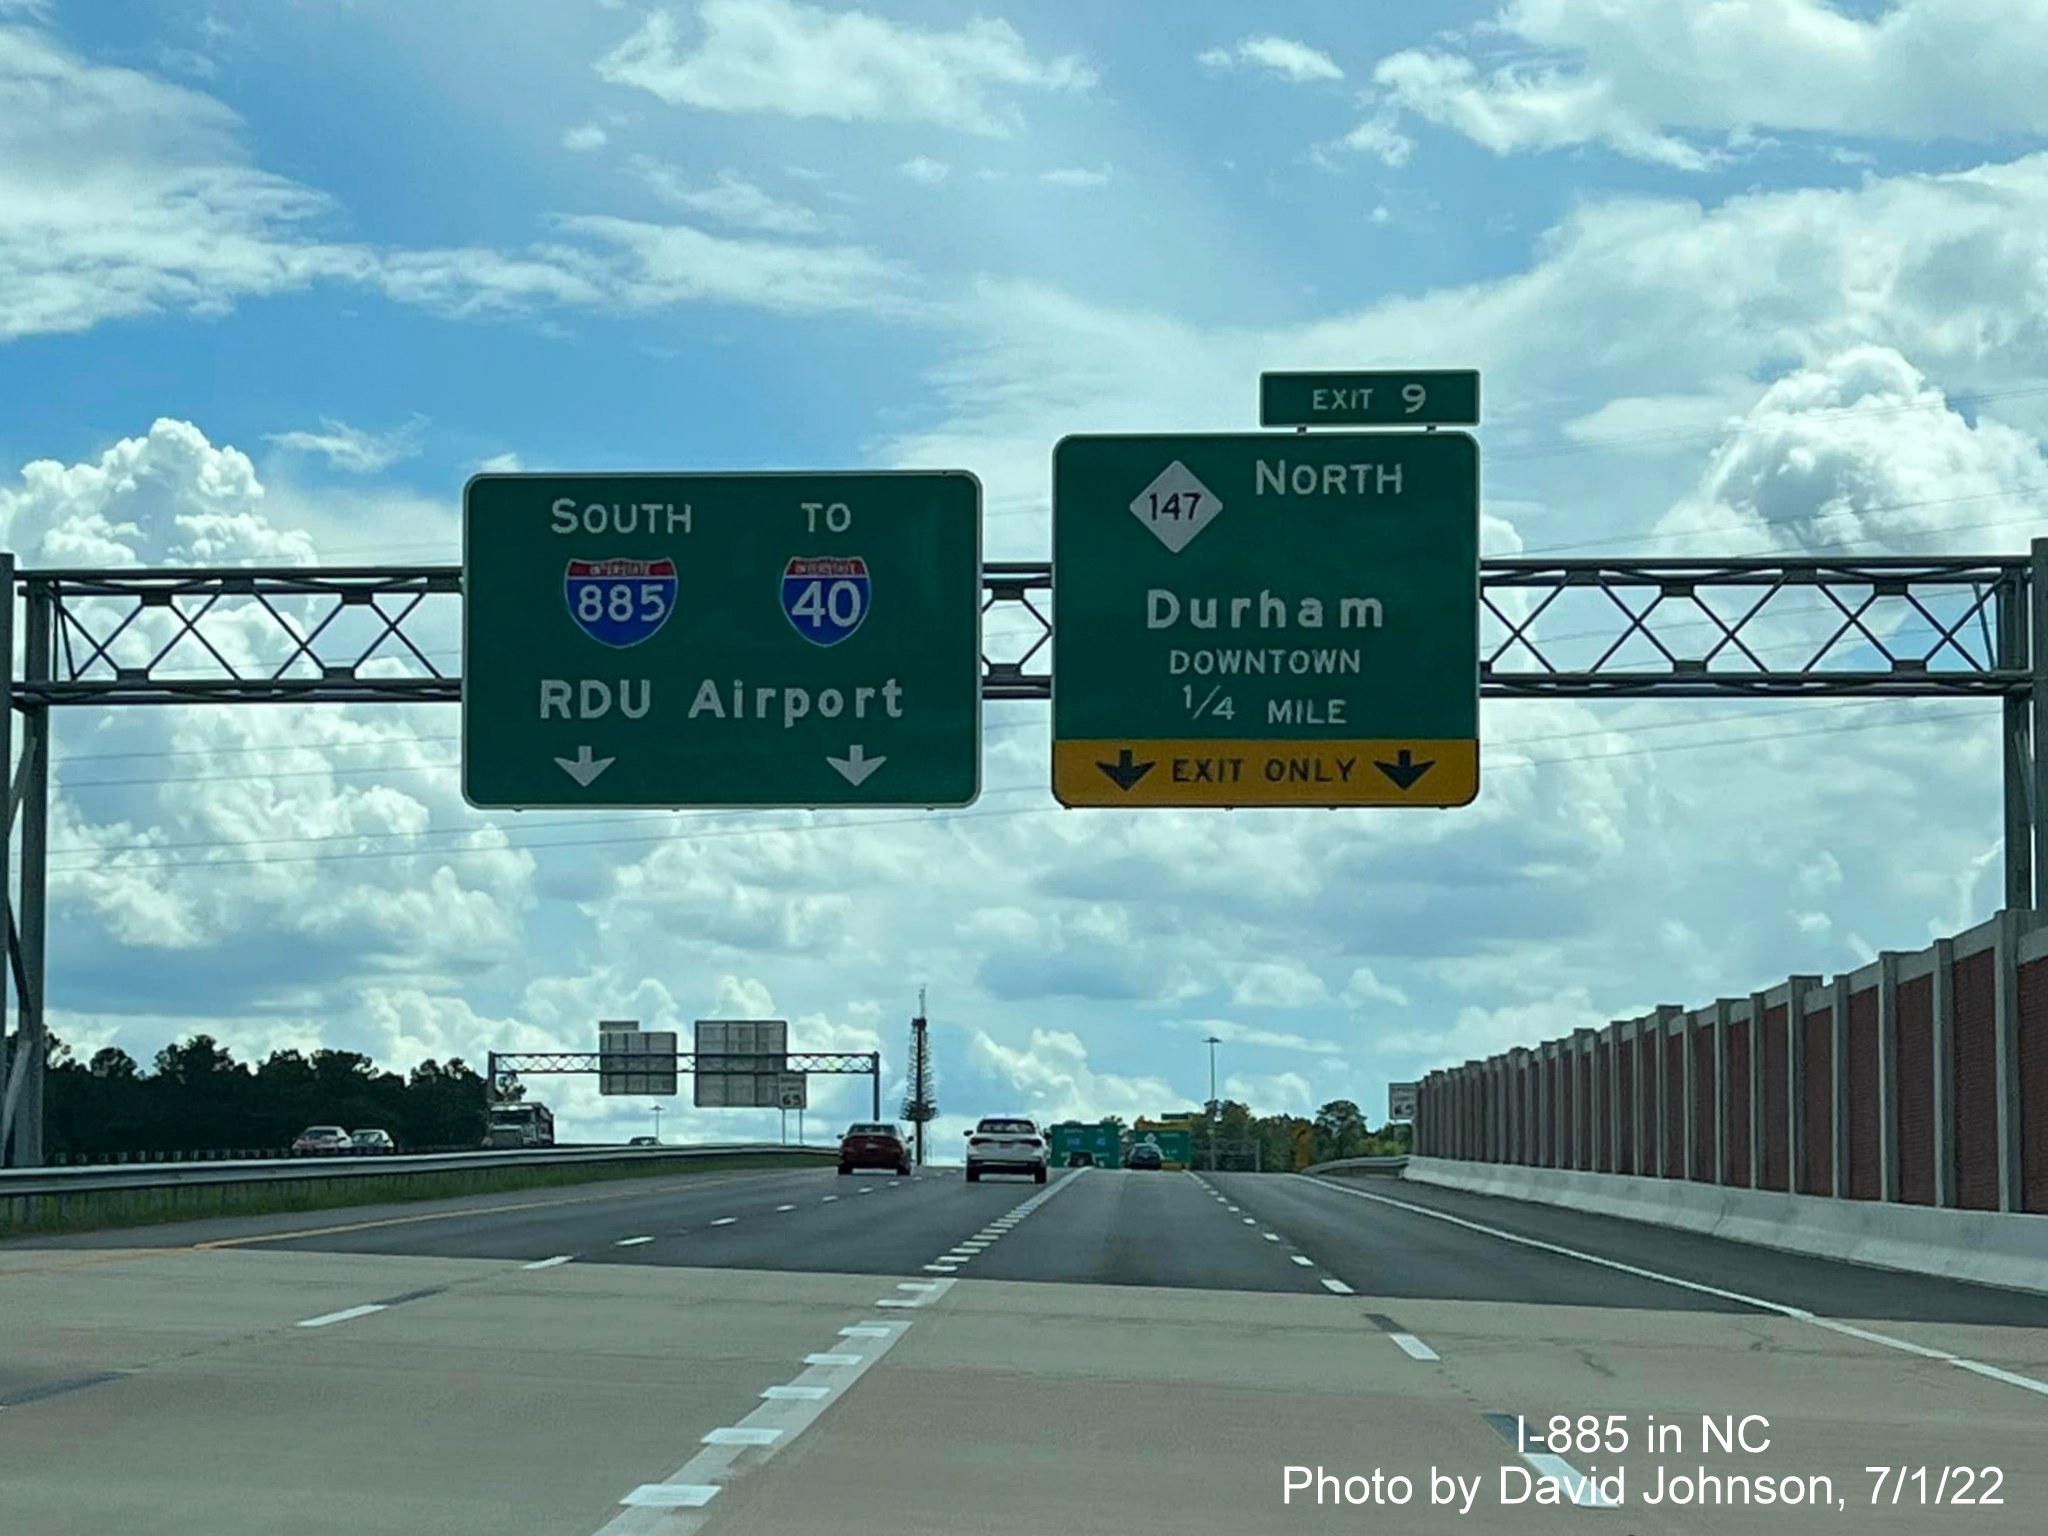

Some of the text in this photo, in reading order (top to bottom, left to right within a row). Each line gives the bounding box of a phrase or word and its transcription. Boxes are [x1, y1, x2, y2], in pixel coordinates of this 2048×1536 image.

[1313, 383, 1426, 413] EXIT 9
[1255, 459, 1402, 495] NORTH
[551, 498, 691, 534] SOUTH
[801, 502, 852, 532] TO
[1149, 493, 1201, 521] 147
[578, 584, 665, 622] 885
[792, 580, 861, 628] 40
[1147, 588, 1383, 628] Durham
[1170, 649, 1360, 675] DOWNTOWN
[539, 678, 903, 728] RDU Airport
[1182, 684, 1347, 725] 1/4 MILE
[1172, 758, 1357, 783] EXIT ONLY
